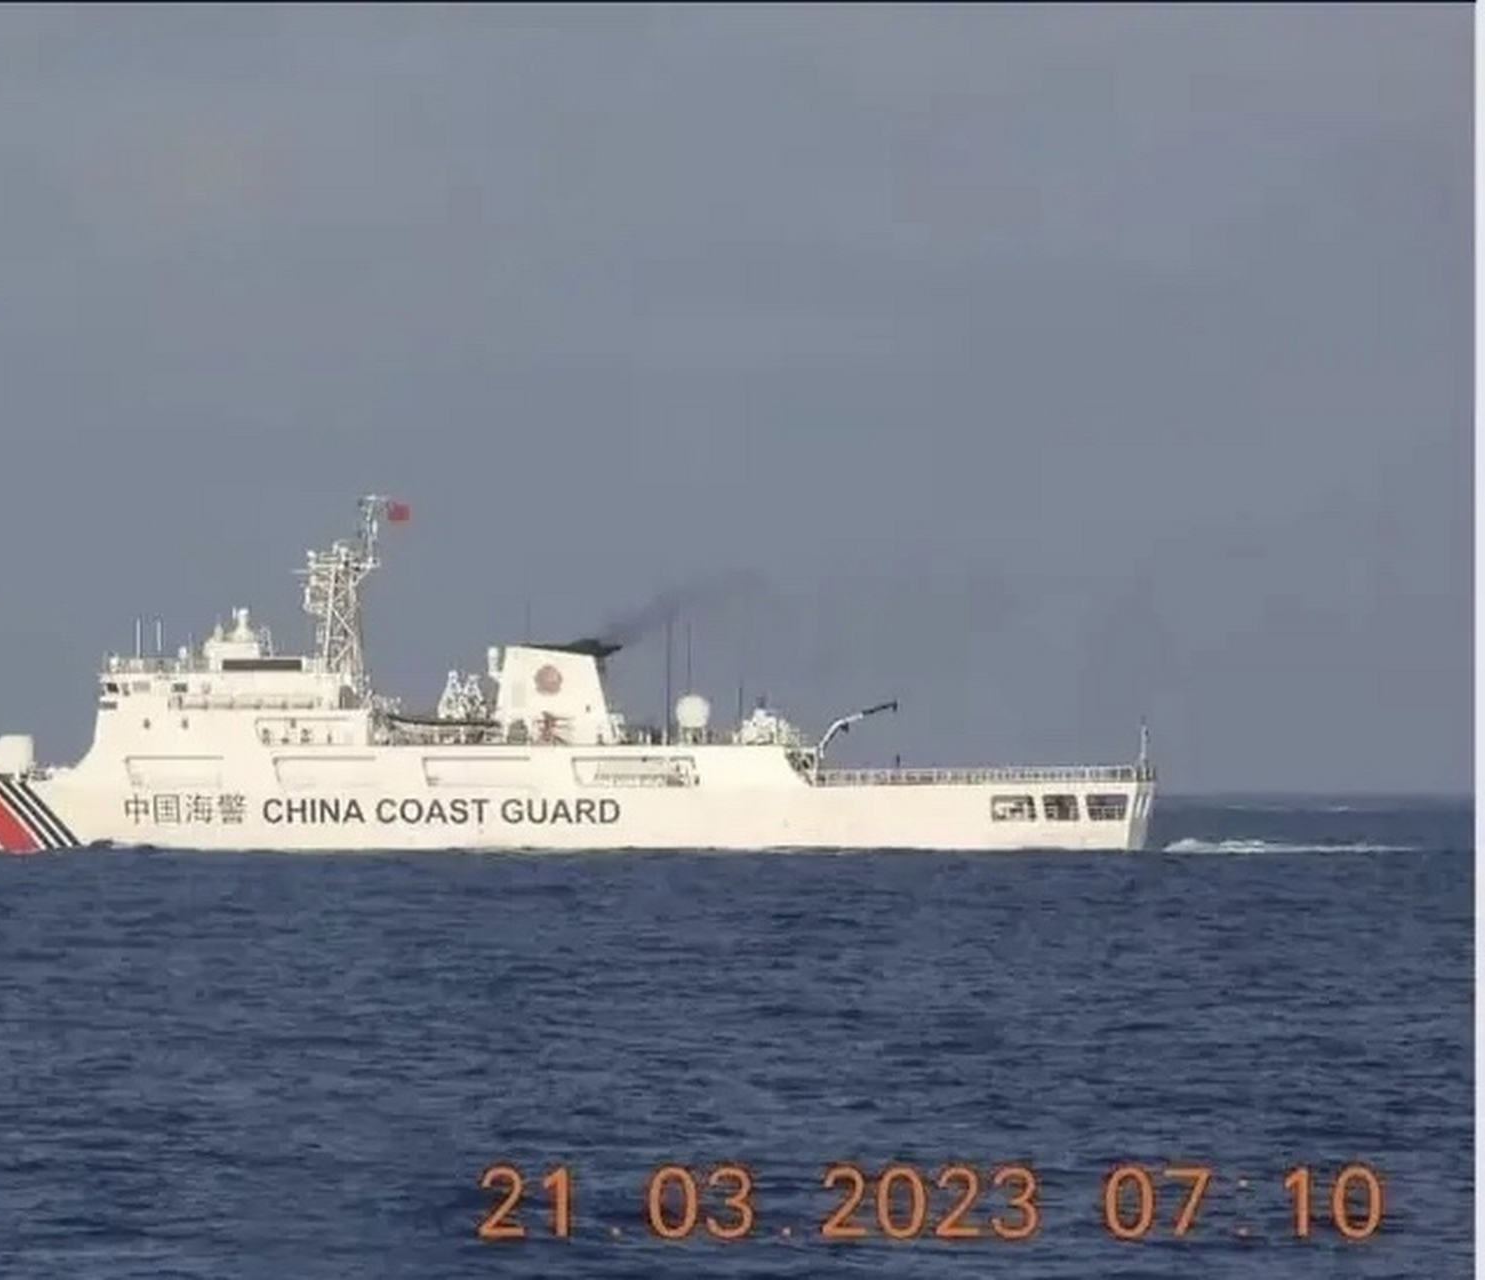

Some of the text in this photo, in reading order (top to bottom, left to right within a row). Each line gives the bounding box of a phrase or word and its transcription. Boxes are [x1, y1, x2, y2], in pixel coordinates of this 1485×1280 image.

[123, 794, 247, 825] 中国海警
[262, 798, 622, 825] CHINA COAST GUARD
